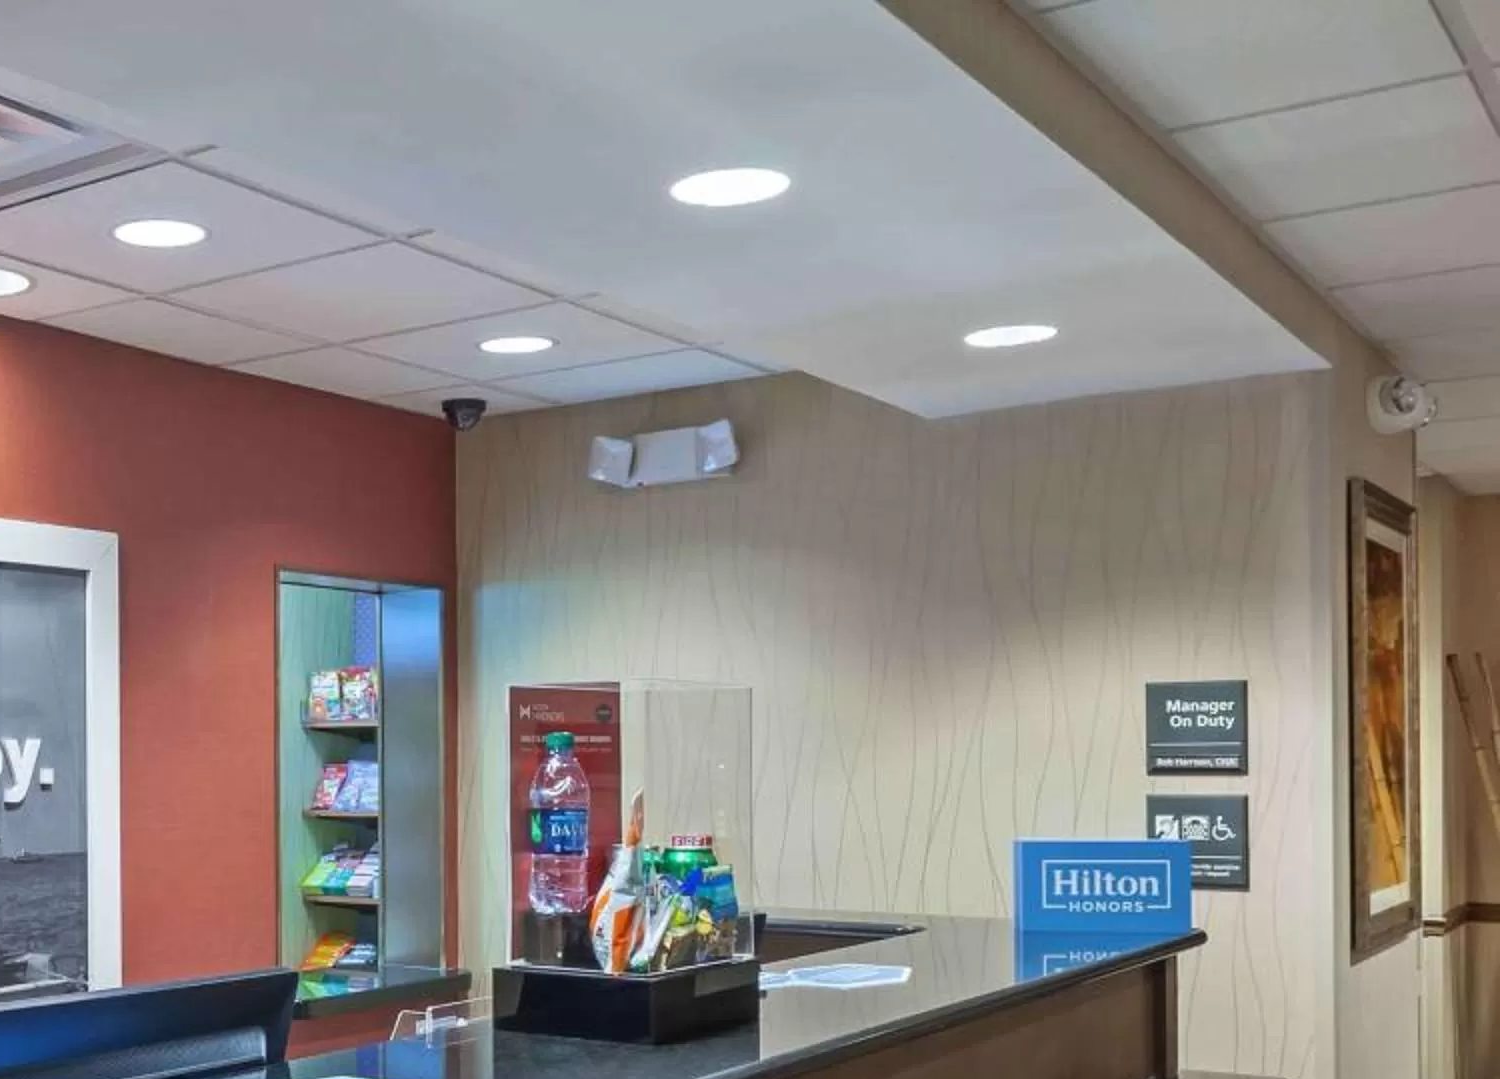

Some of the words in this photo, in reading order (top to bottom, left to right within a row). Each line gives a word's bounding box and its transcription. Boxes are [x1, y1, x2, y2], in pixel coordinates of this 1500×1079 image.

[1165, 699, 1236, 714] Manager
[1169, 715, 1193, 728] On
[1197, 715, 1235, 730] Duty
[1053, 869, 1160, 897] Hilton
[1068, 900, 1145, 913] HONORS
